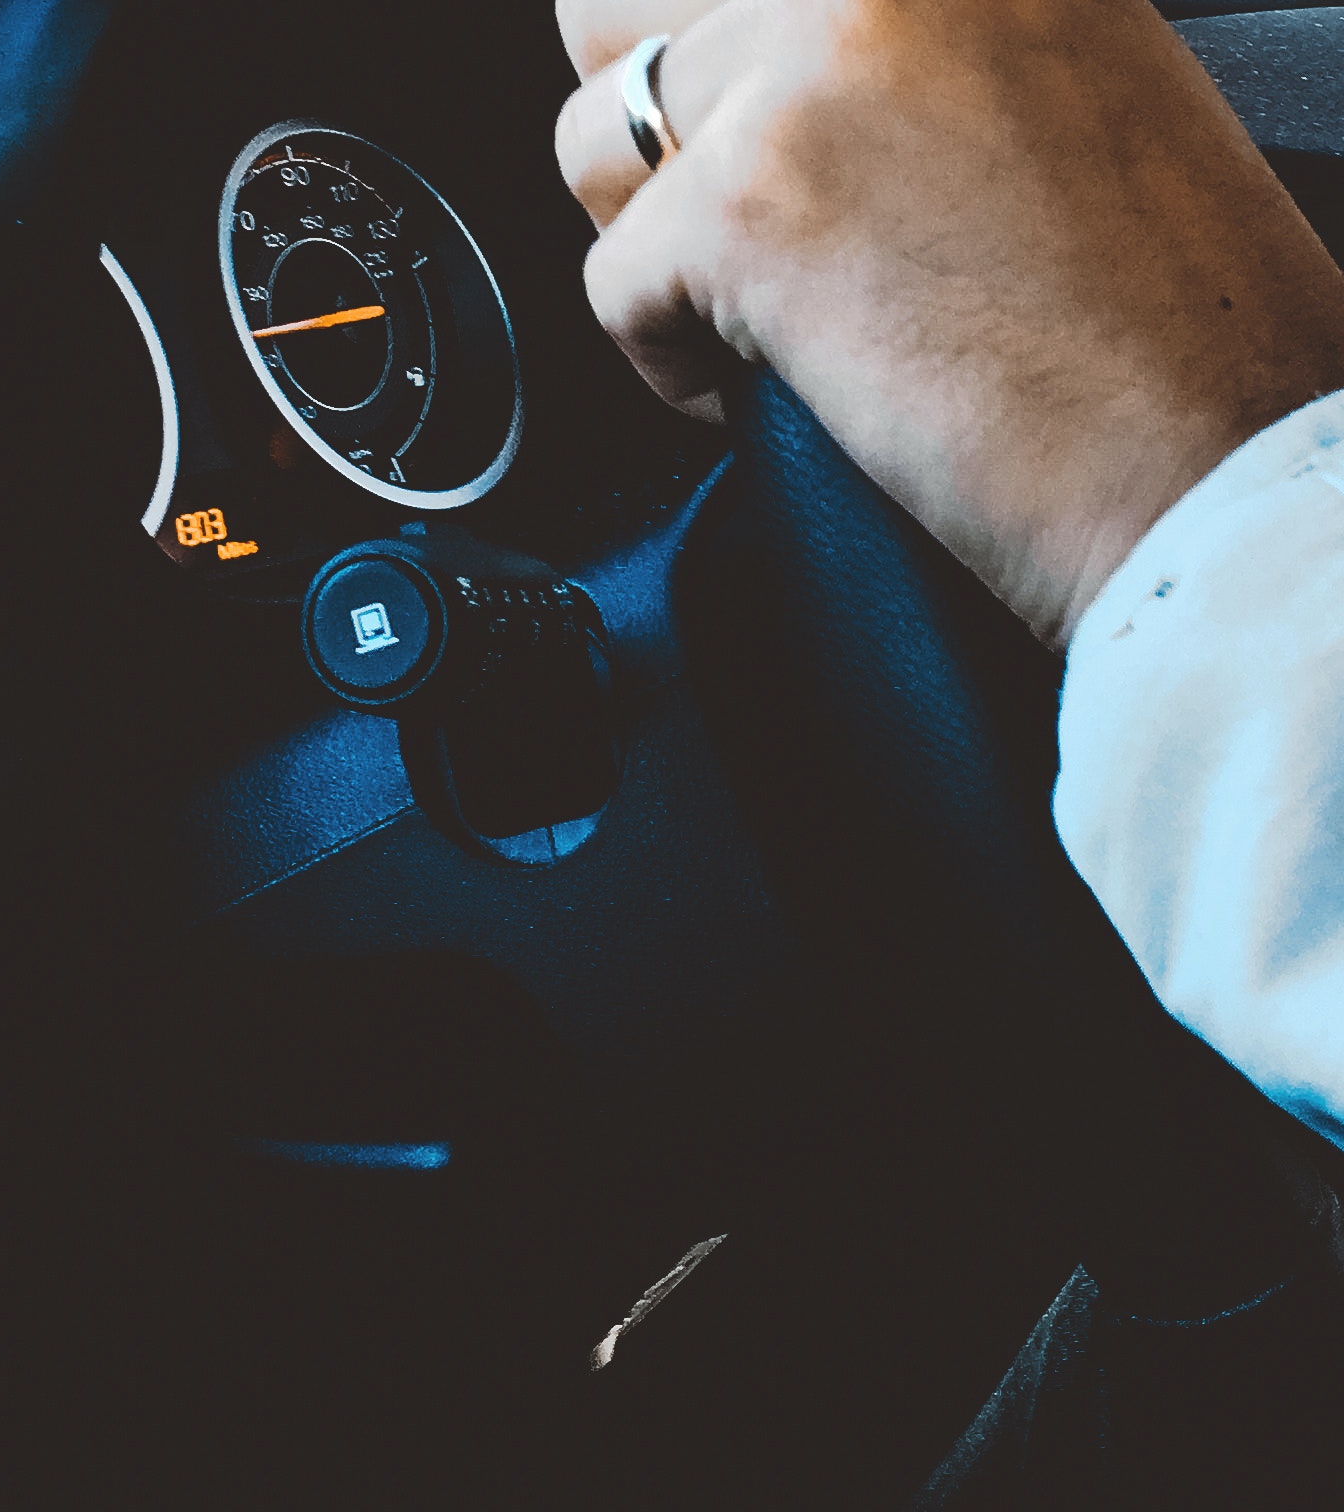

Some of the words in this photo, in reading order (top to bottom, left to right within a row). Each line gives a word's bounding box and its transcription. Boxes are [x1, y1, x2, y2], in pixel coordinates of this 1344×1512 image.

[281, 165, 311, 186] 90
[329, 182, 359, 203] 110
[232, 210, 256, 232] 0
[175, 507, 228, 547] 803
